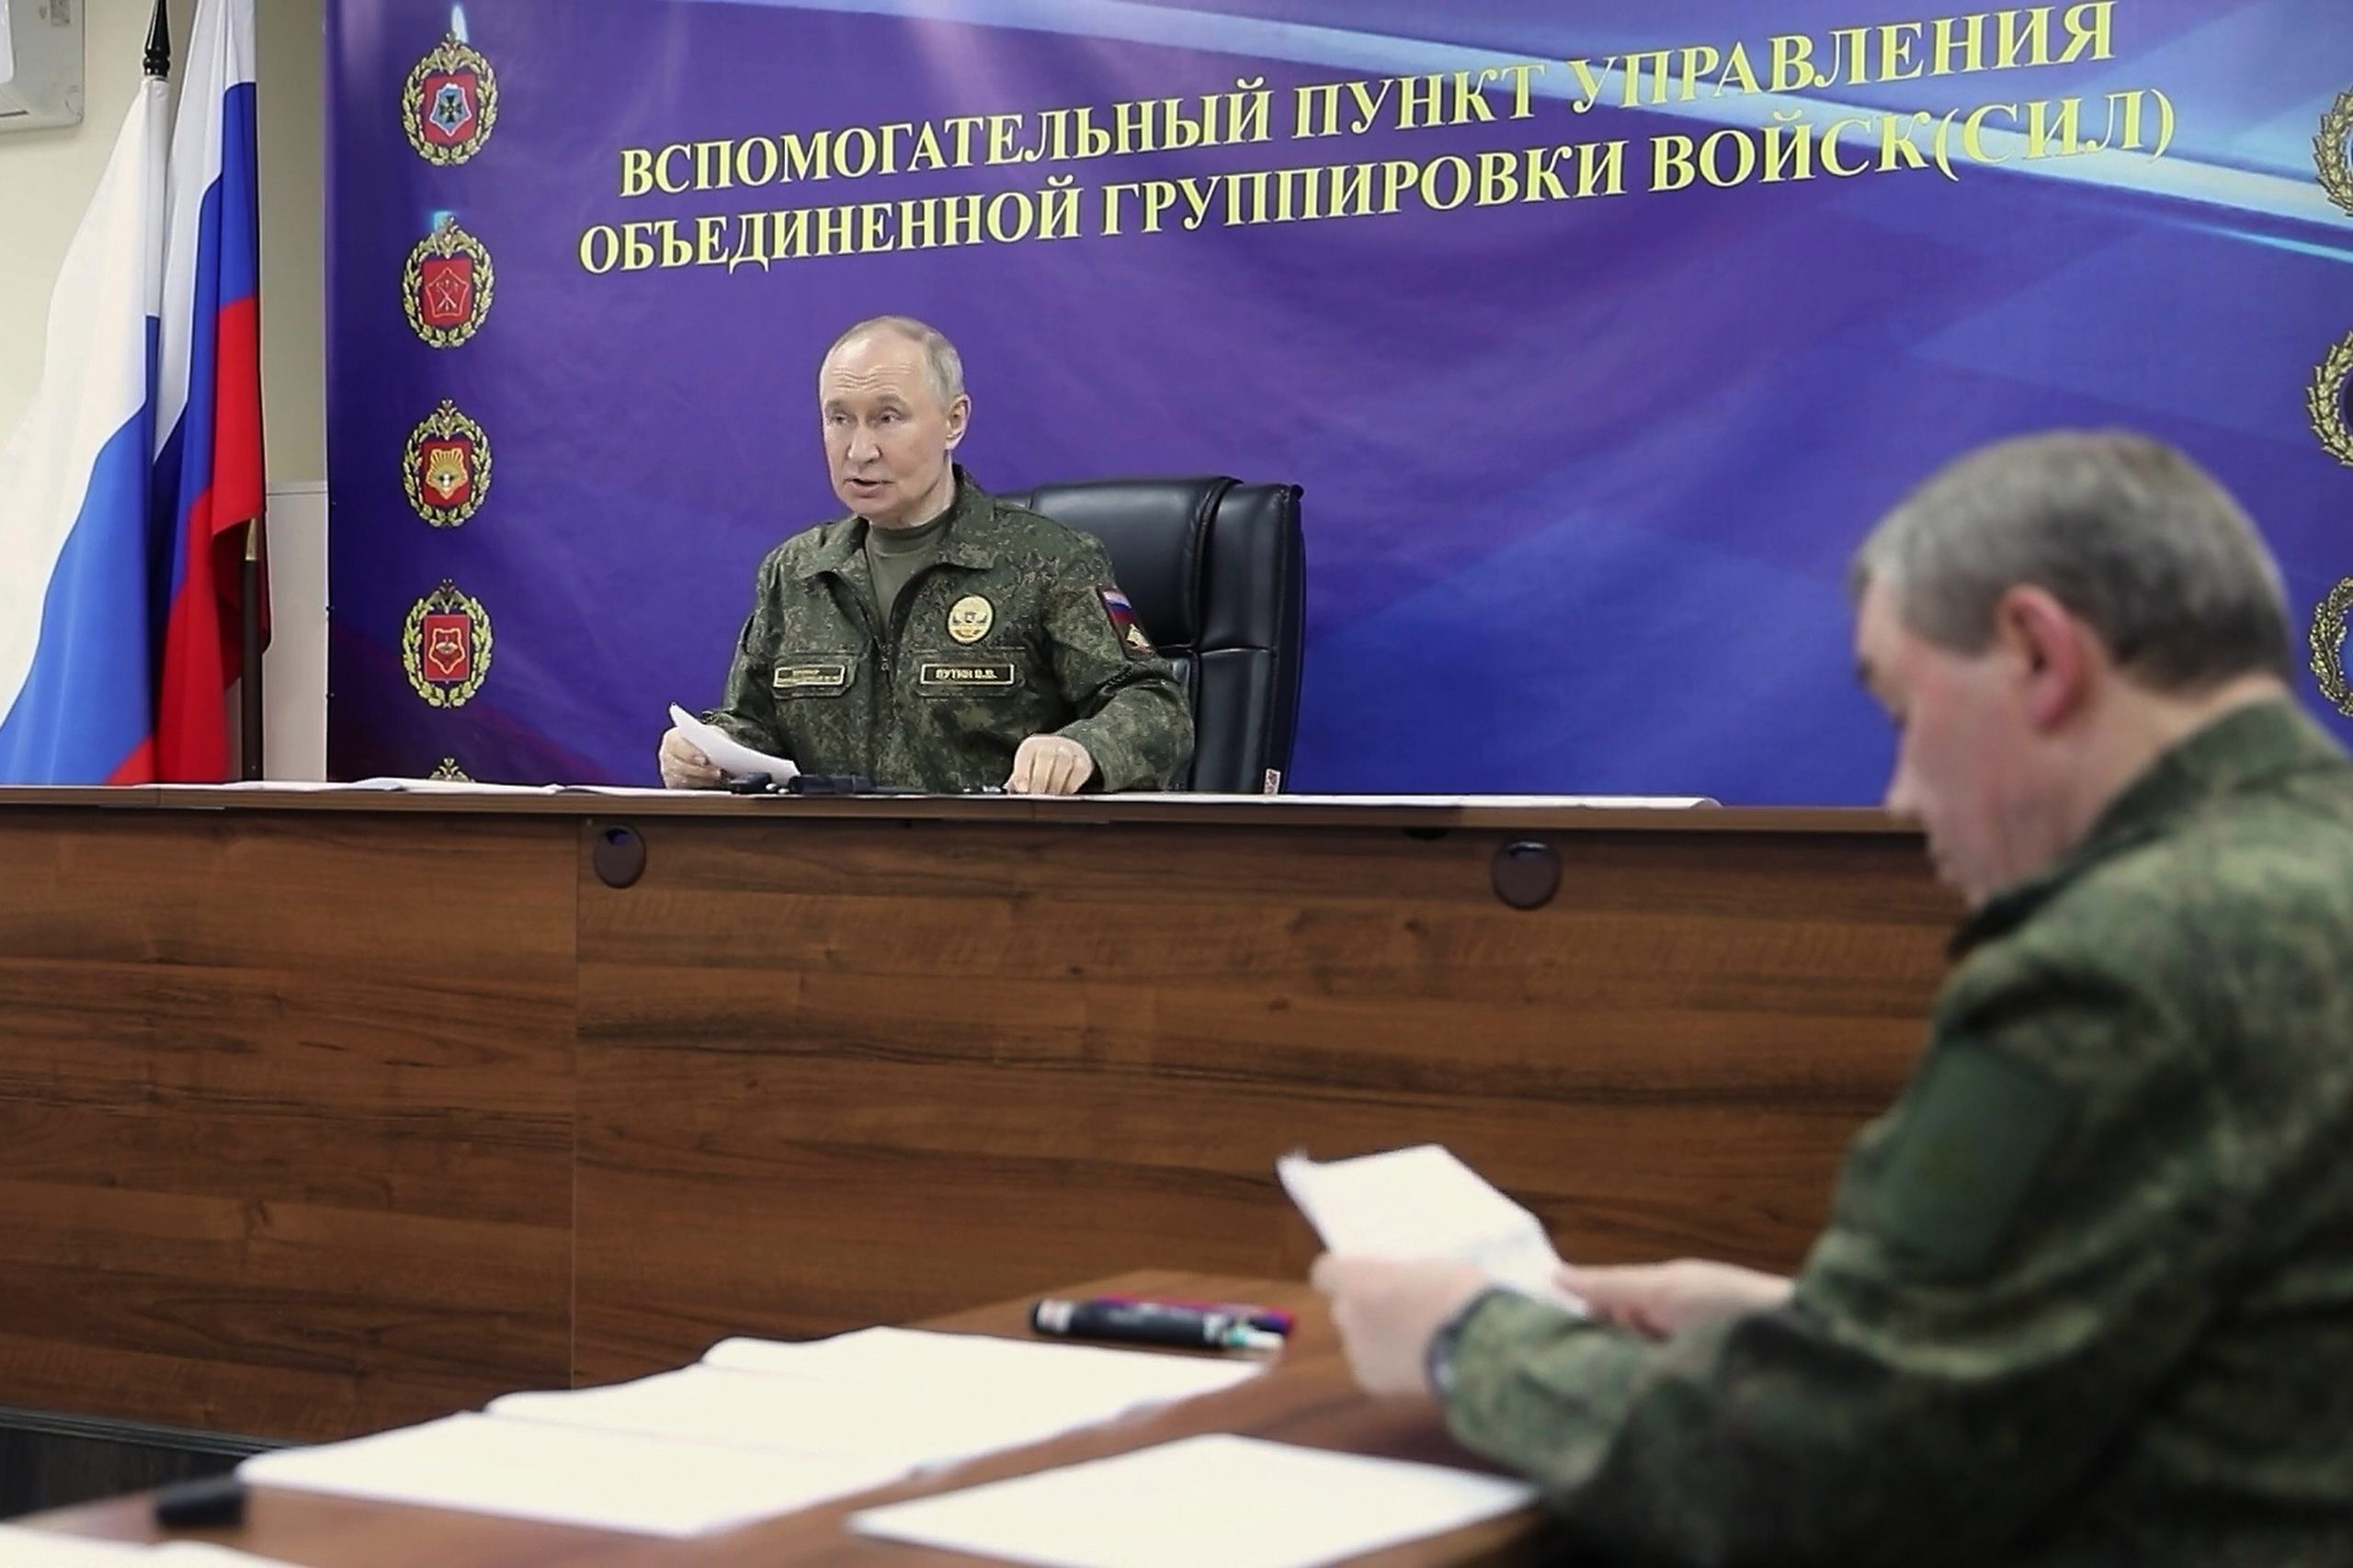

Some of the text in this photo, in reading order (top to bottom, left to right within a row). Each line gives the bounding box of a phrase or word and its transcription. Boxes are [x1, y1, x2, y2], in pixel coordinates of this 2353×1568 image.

[620, 1, 2117, 198] ВСПОМОГАТЕЛЬНЫЙ ПУНКТ УПРАВЛЕНИЯ
[578, 175, 1081, 274] ОБЪЕДИНЕННОЙ
[1100, 142, 1628, 236] ГРУППИРОВКИ
